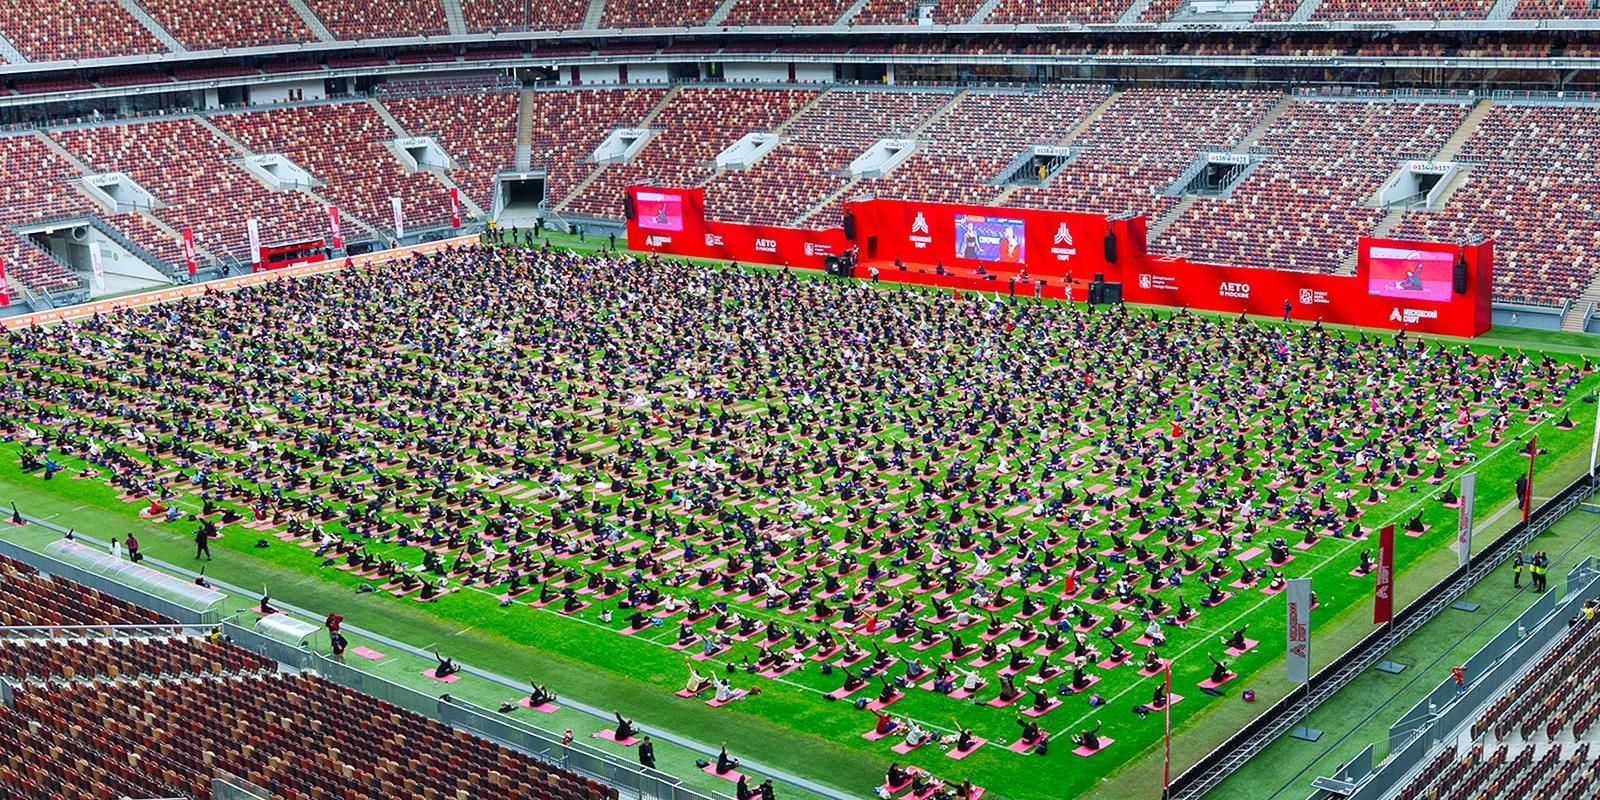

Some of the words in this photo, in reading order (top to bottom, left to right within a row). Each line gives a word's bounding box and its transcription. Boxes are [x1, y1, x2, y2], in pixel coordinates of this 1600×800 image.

[756, 238, 776, 248] ЛЕТО
[1220, 282, 1250, 292] ЛЕТО
[1403, 308, 1438, 318] МОСКОВСКИЙ
[1288, 602, 1298, 642] МОСКОВСКИЙ
[1297, 624, 1306, 642] СПОРТ
